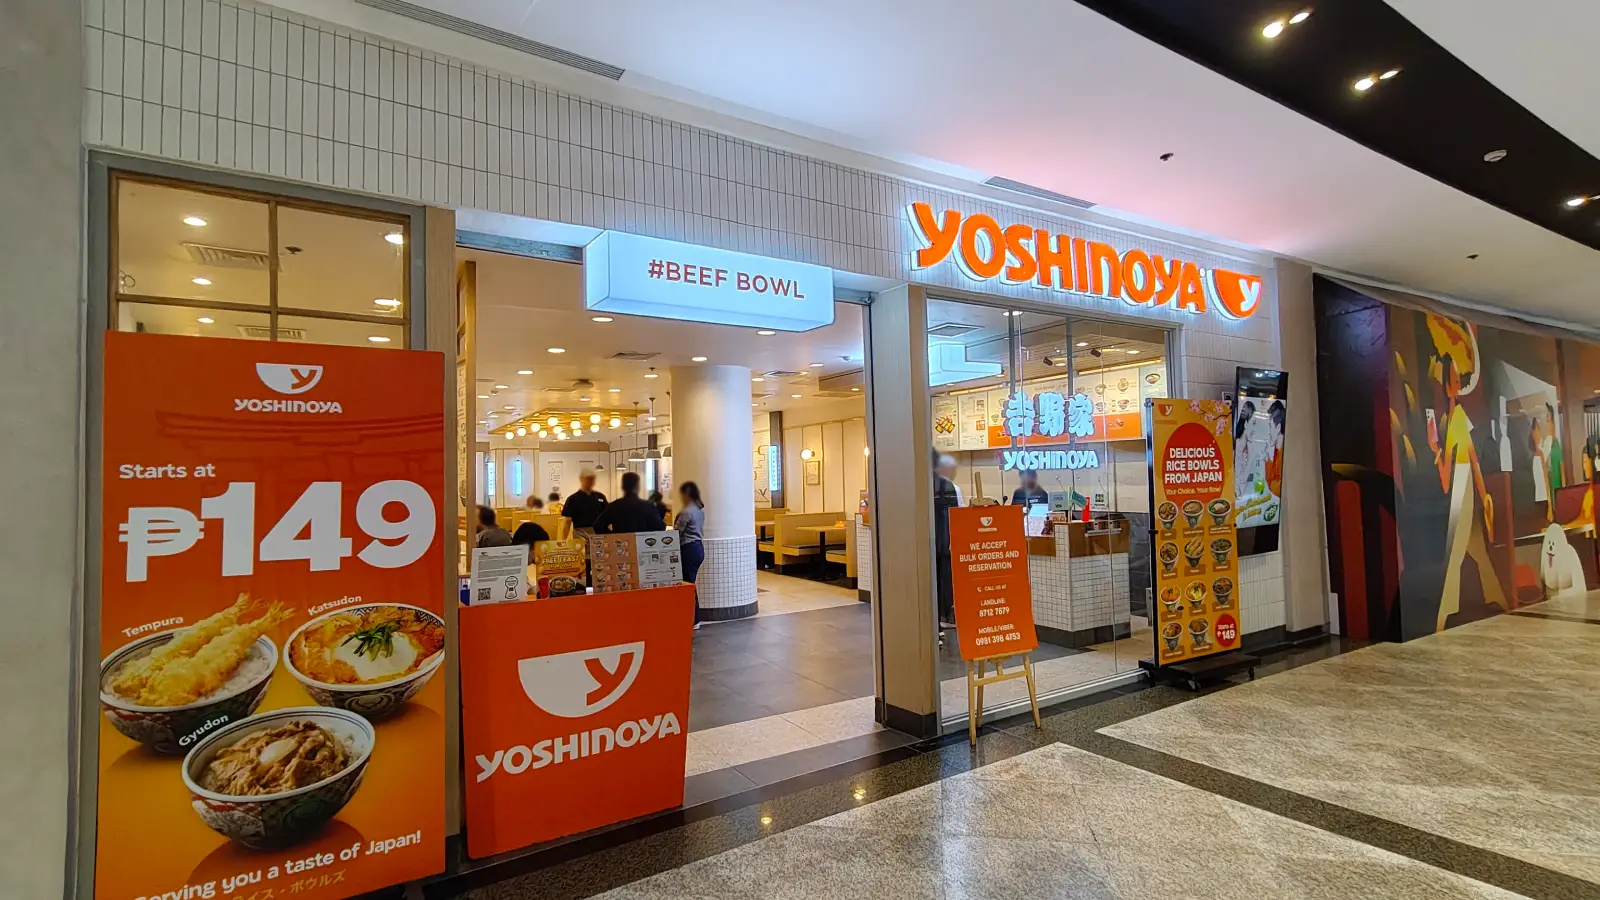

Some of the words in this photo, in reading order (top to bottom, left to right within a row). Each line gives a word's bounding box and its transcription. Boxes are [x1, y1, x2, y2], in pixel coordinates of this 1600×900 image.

[911, 201, 1207, 313] YOSHINOYA
[648, 259, 728, 288] #BEEF
[736, 271, 805, 299] BOWL
[234, 398, 343, 414] YOSHINOYA
[1003, 449, 1099, 471] YOSHINOYA
[1169, 447, 1216, 459] DELICIOUS
[119, 463, 187, 480] Starts
[193, 463, 216, 479] at
[1166, 460, 1186, 471] RICE
[1187, 459, 1220, 471] BOWLS
[1164, 472, 1190, 485] FROM
[1191, 471, 1223, 483] JAPAN
[969, 543, 980, 551] WE
[981, 540, 1007, 550] ACCEPT
[959, 553, 977, 563] BULK
[978, 551, 1003, 561] ORDERS
[1005, 550, 1020, 559] AND
[968, 561, 1012, 572] RESERVATION
[307, 595, 363, 616] Katsudon
[979, 609, 994, 617] 8712
[122, 614, 184, 639] Tempura
[178, 713, 230, 748] Gyudon
[475, 712, 681, 784] YOSHINOYA
[221, 869, 262, 895] you
[267, 865, 279, 880] a
[284, 852, 335, 875] taste
[339, 842, 362, 862] of
[365, 830, 422, 856] Japan!
